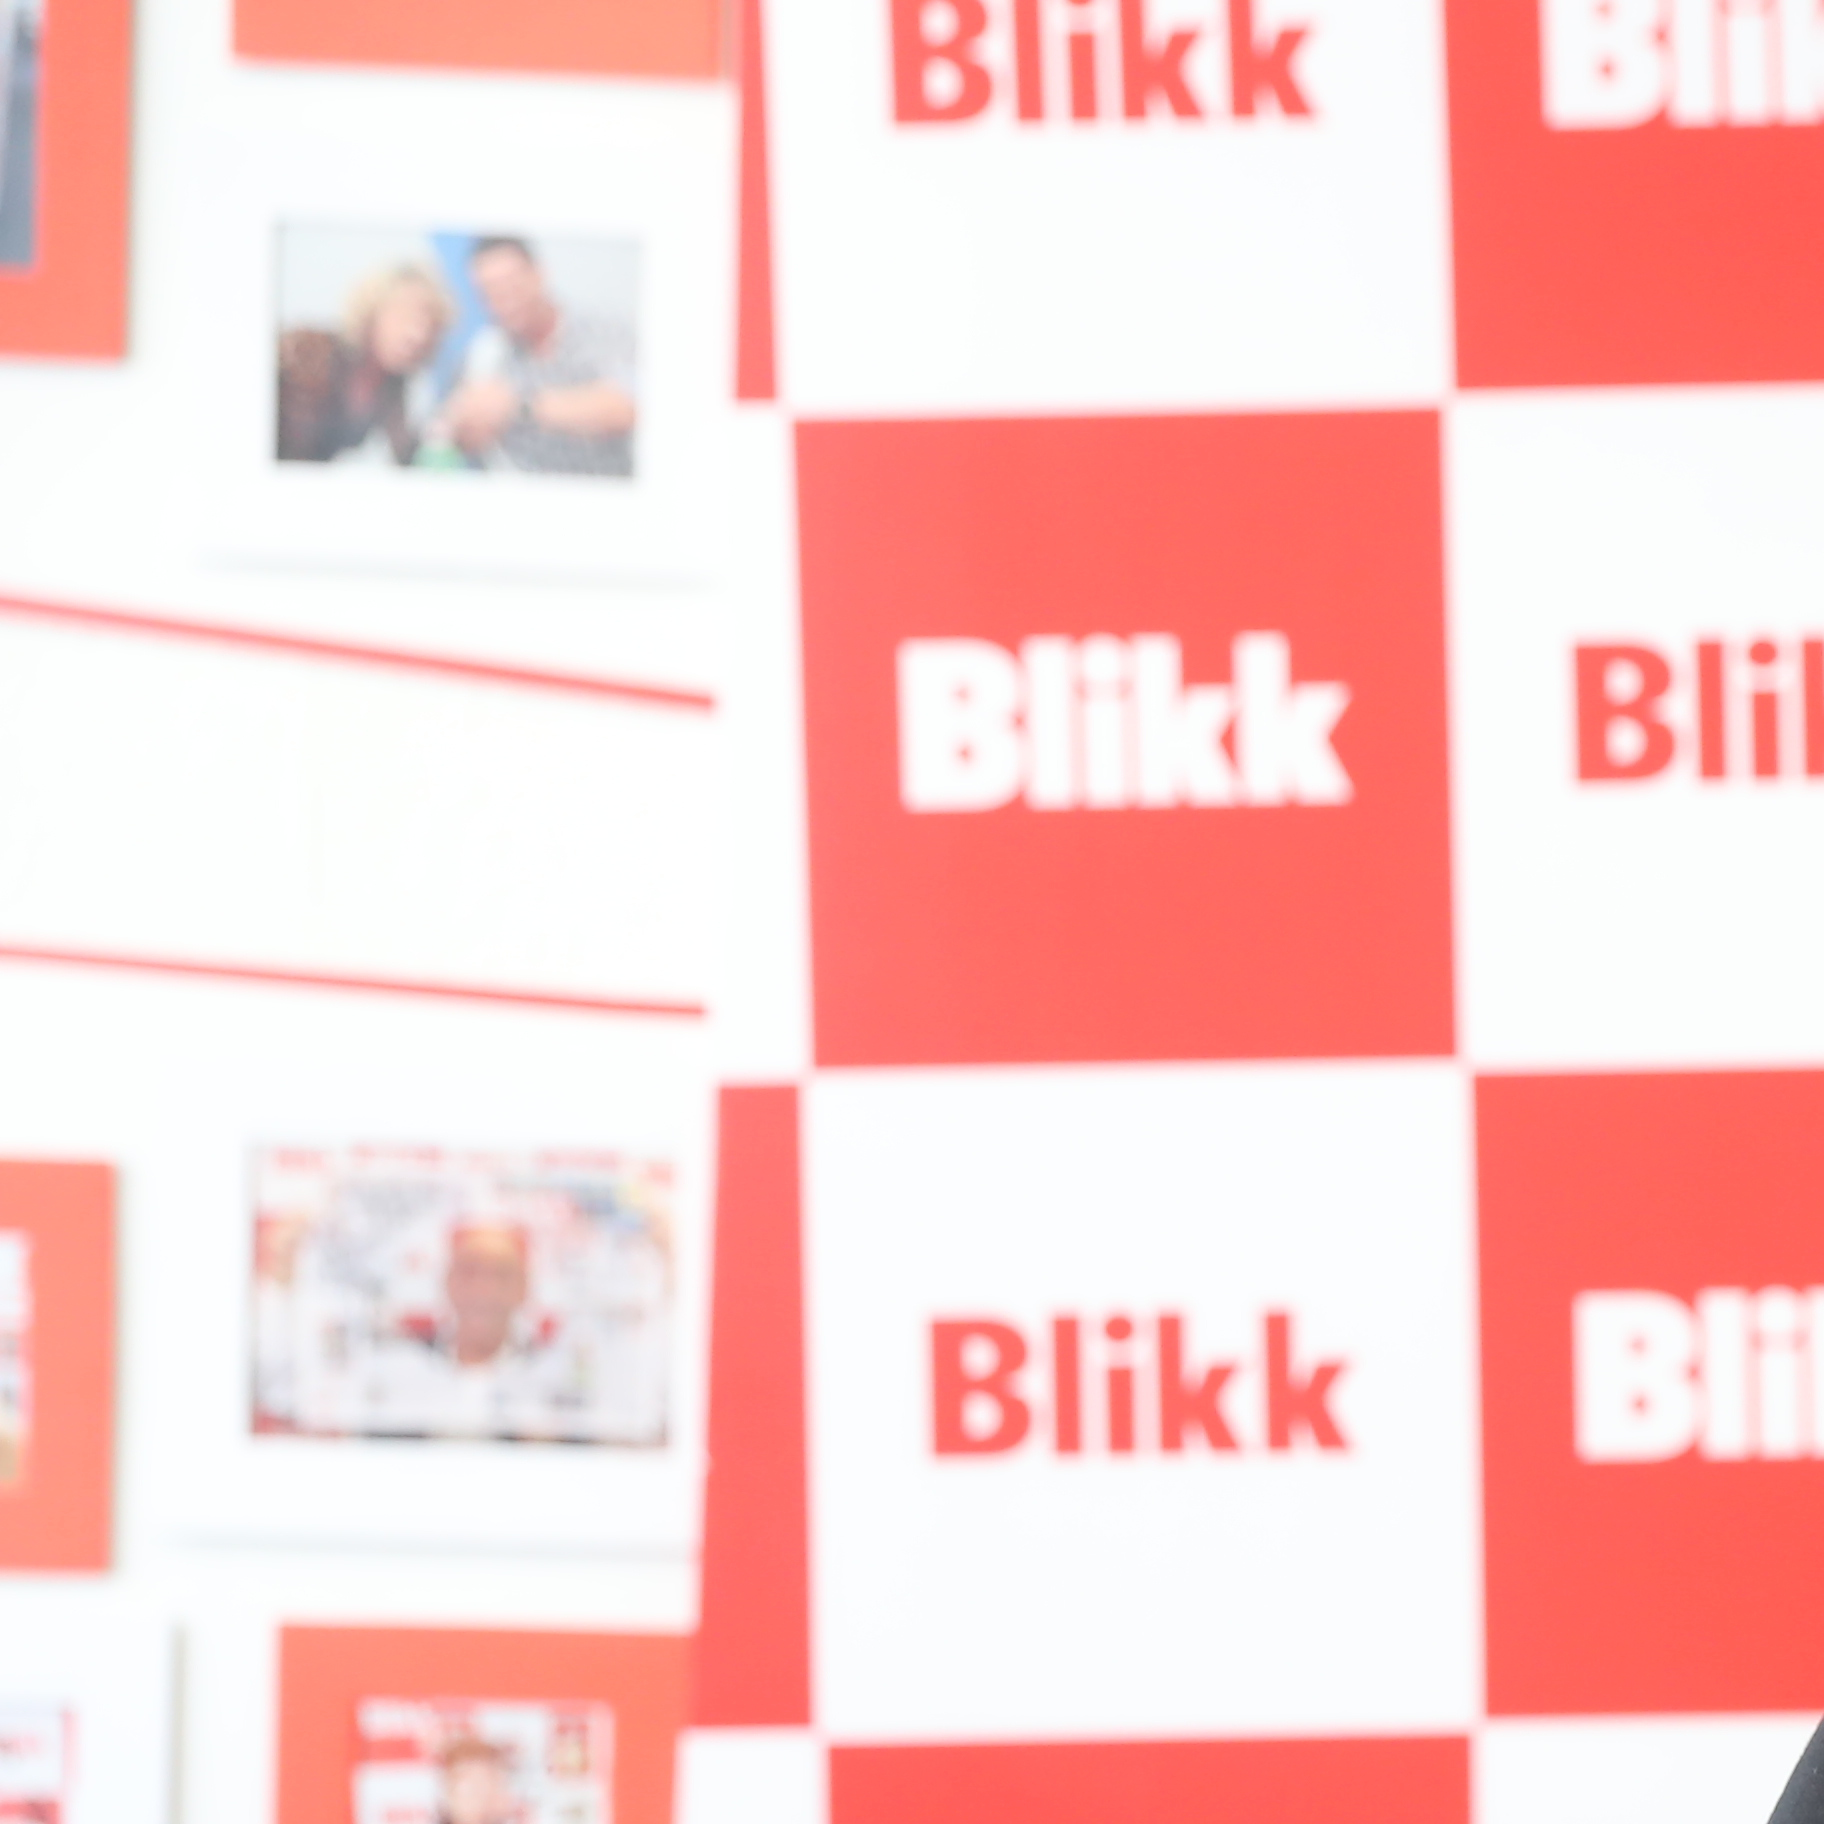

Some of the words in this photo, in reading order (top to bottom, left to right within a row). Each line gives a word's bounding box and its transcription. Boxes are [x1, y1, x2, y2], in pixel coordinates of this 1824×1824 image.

[890, 0, 1312, 124] Blikk
[898, 634, 1349, 811] Blikk
[931, 1313, 1346, 1456] Blikk
